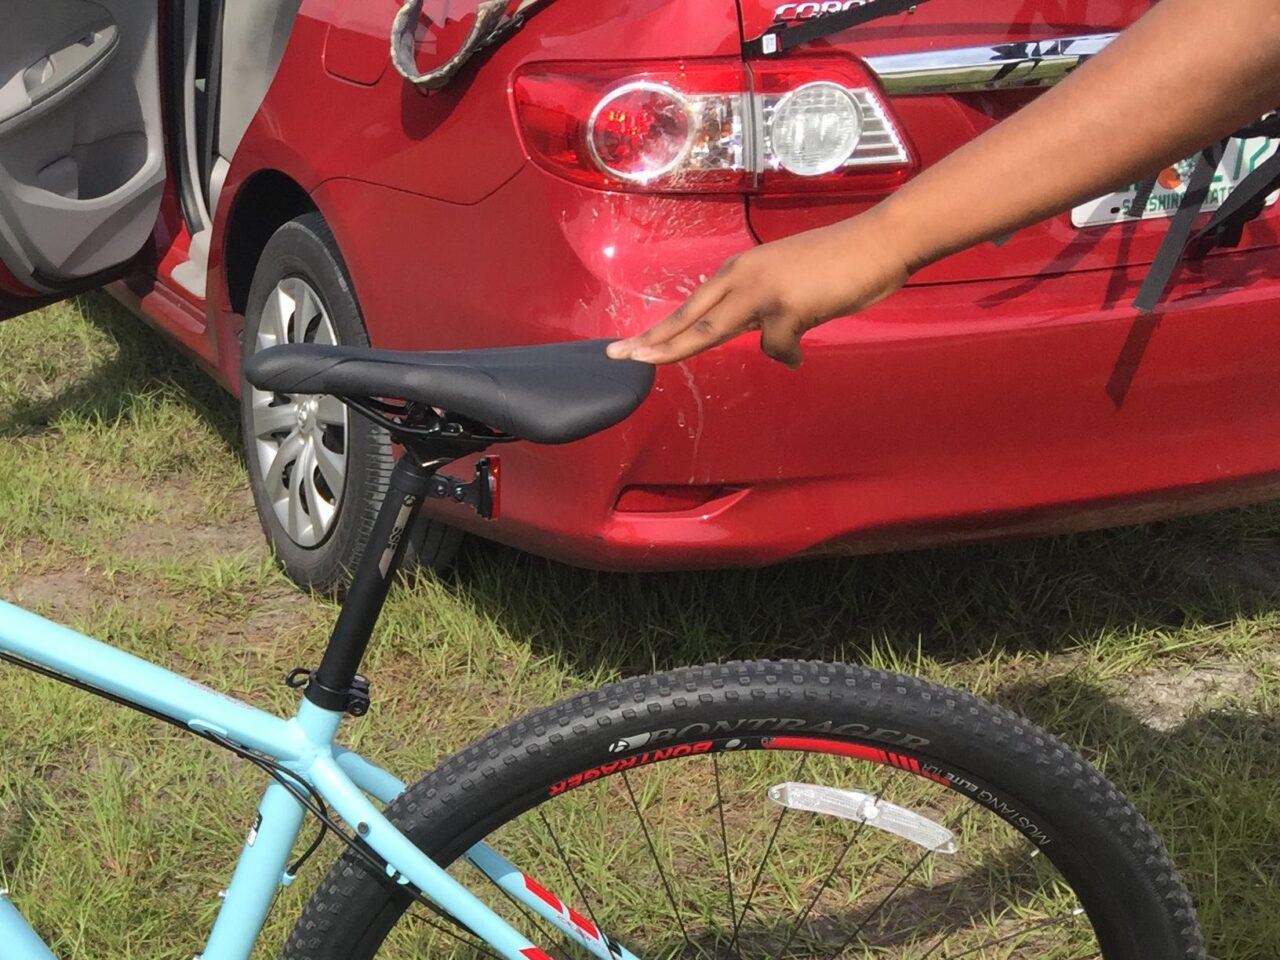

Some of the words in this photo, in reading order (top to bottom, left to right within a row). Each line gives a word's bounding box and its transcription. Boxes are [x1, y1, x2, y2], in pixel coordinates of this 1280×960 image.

[649, 718, 930, 750] BONTRAGER
[548, 740, 713, 796] BONTRAGER
[945, 772, 979, 792] ELITE
[978, 790, 1051, 846] MUSTANG
